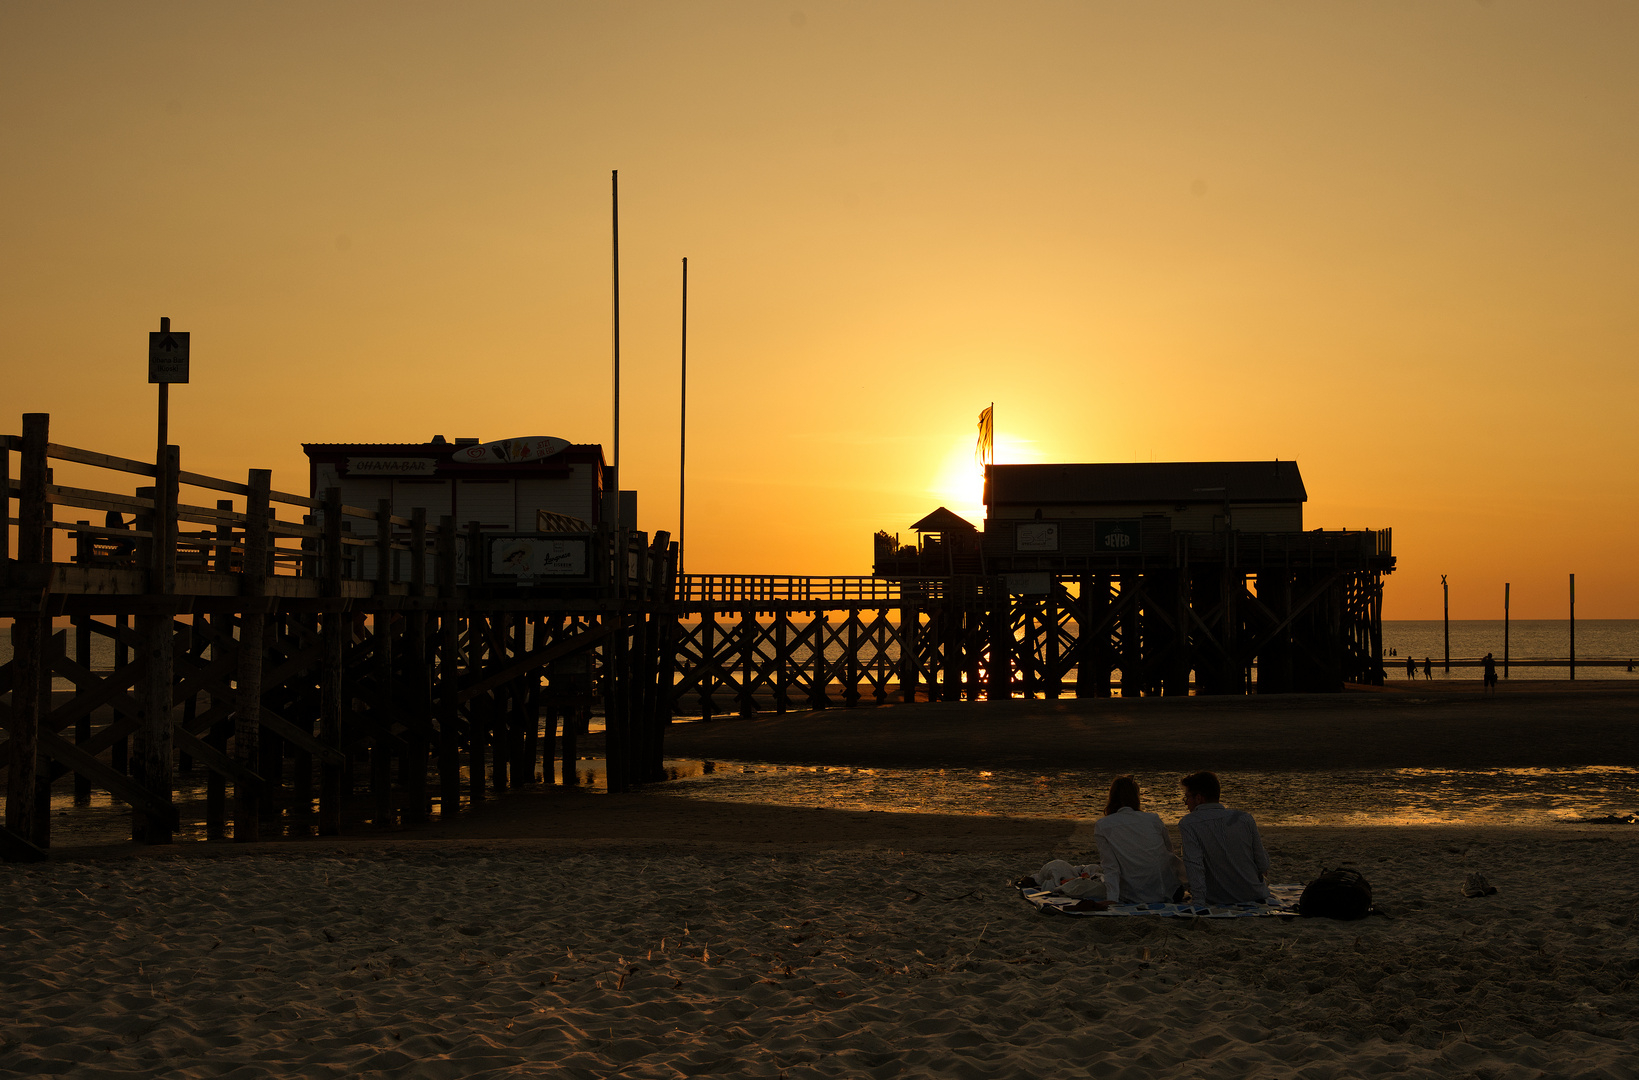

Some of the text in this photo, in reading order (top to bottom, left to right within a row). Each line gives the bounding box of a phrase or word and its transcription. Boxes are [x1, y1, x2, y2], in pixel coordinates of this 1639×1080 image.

[173, 356, 185, 364] Bar
[356, 461, 426, 472] OHANA-BAR
[1104, 533, 1130, 548] JEVER
